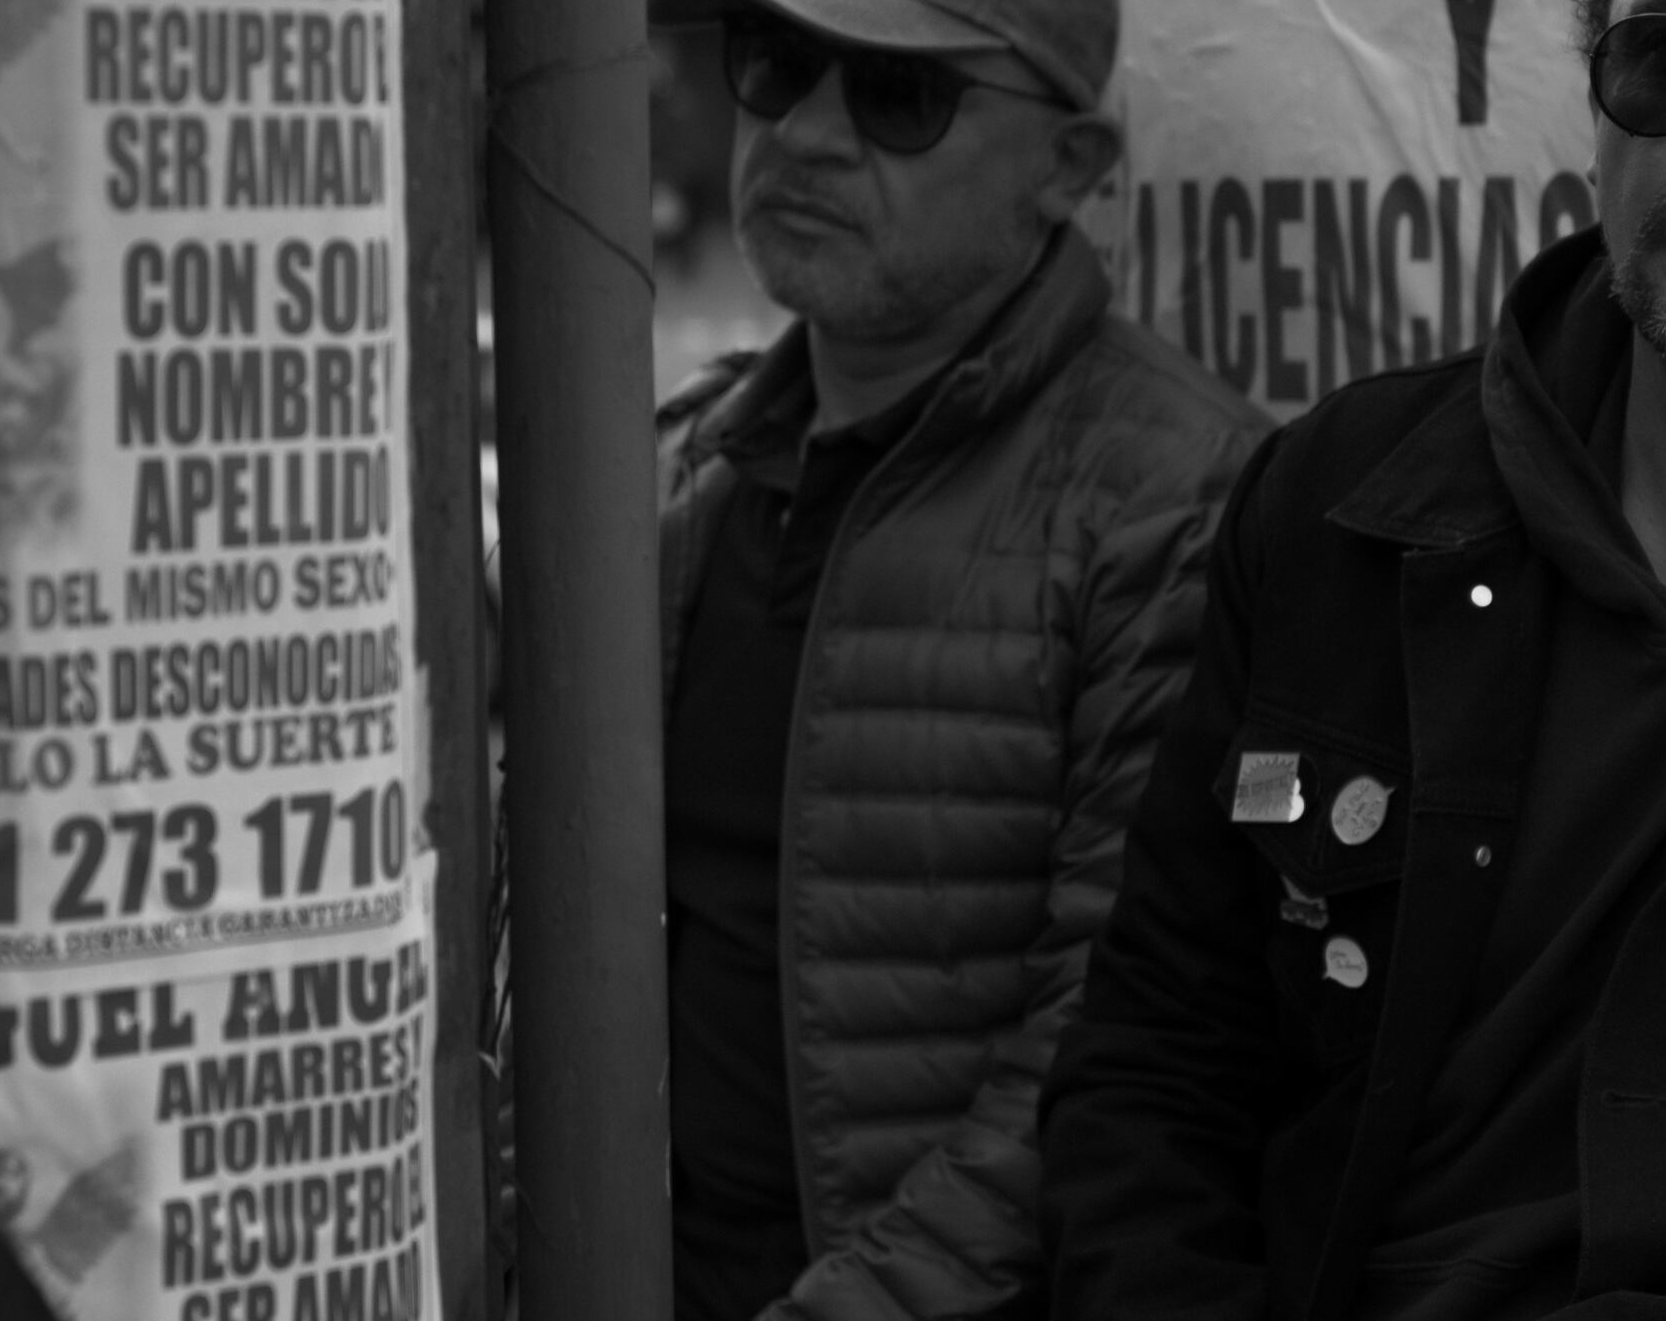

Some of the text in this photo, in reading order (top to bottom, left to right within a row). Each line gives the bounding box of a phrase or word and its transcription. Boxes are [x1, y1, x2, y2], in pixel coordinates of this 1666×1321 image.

[85, 7, 370, 105] RECUPERO
[107, 113, 210, 210] SER
[125, 239, 256, 339] CON
[1139, 171, 1598, 401] LICENCIA
[118, 345, 378, 448] NOMBRE
[27, 570, 110, 631] DEL
[126, 560, 280, 625] MISMO
[91, 728, 169, 788] LA
[186, 703, 397, 774] SUERTE
[52, 803, 218, 923] 273
[245, 779, 406, 899] 1710
[157, 1032, 407, 1123] AMARRES
[164, 1156, 407, 1289] RECUPERO
